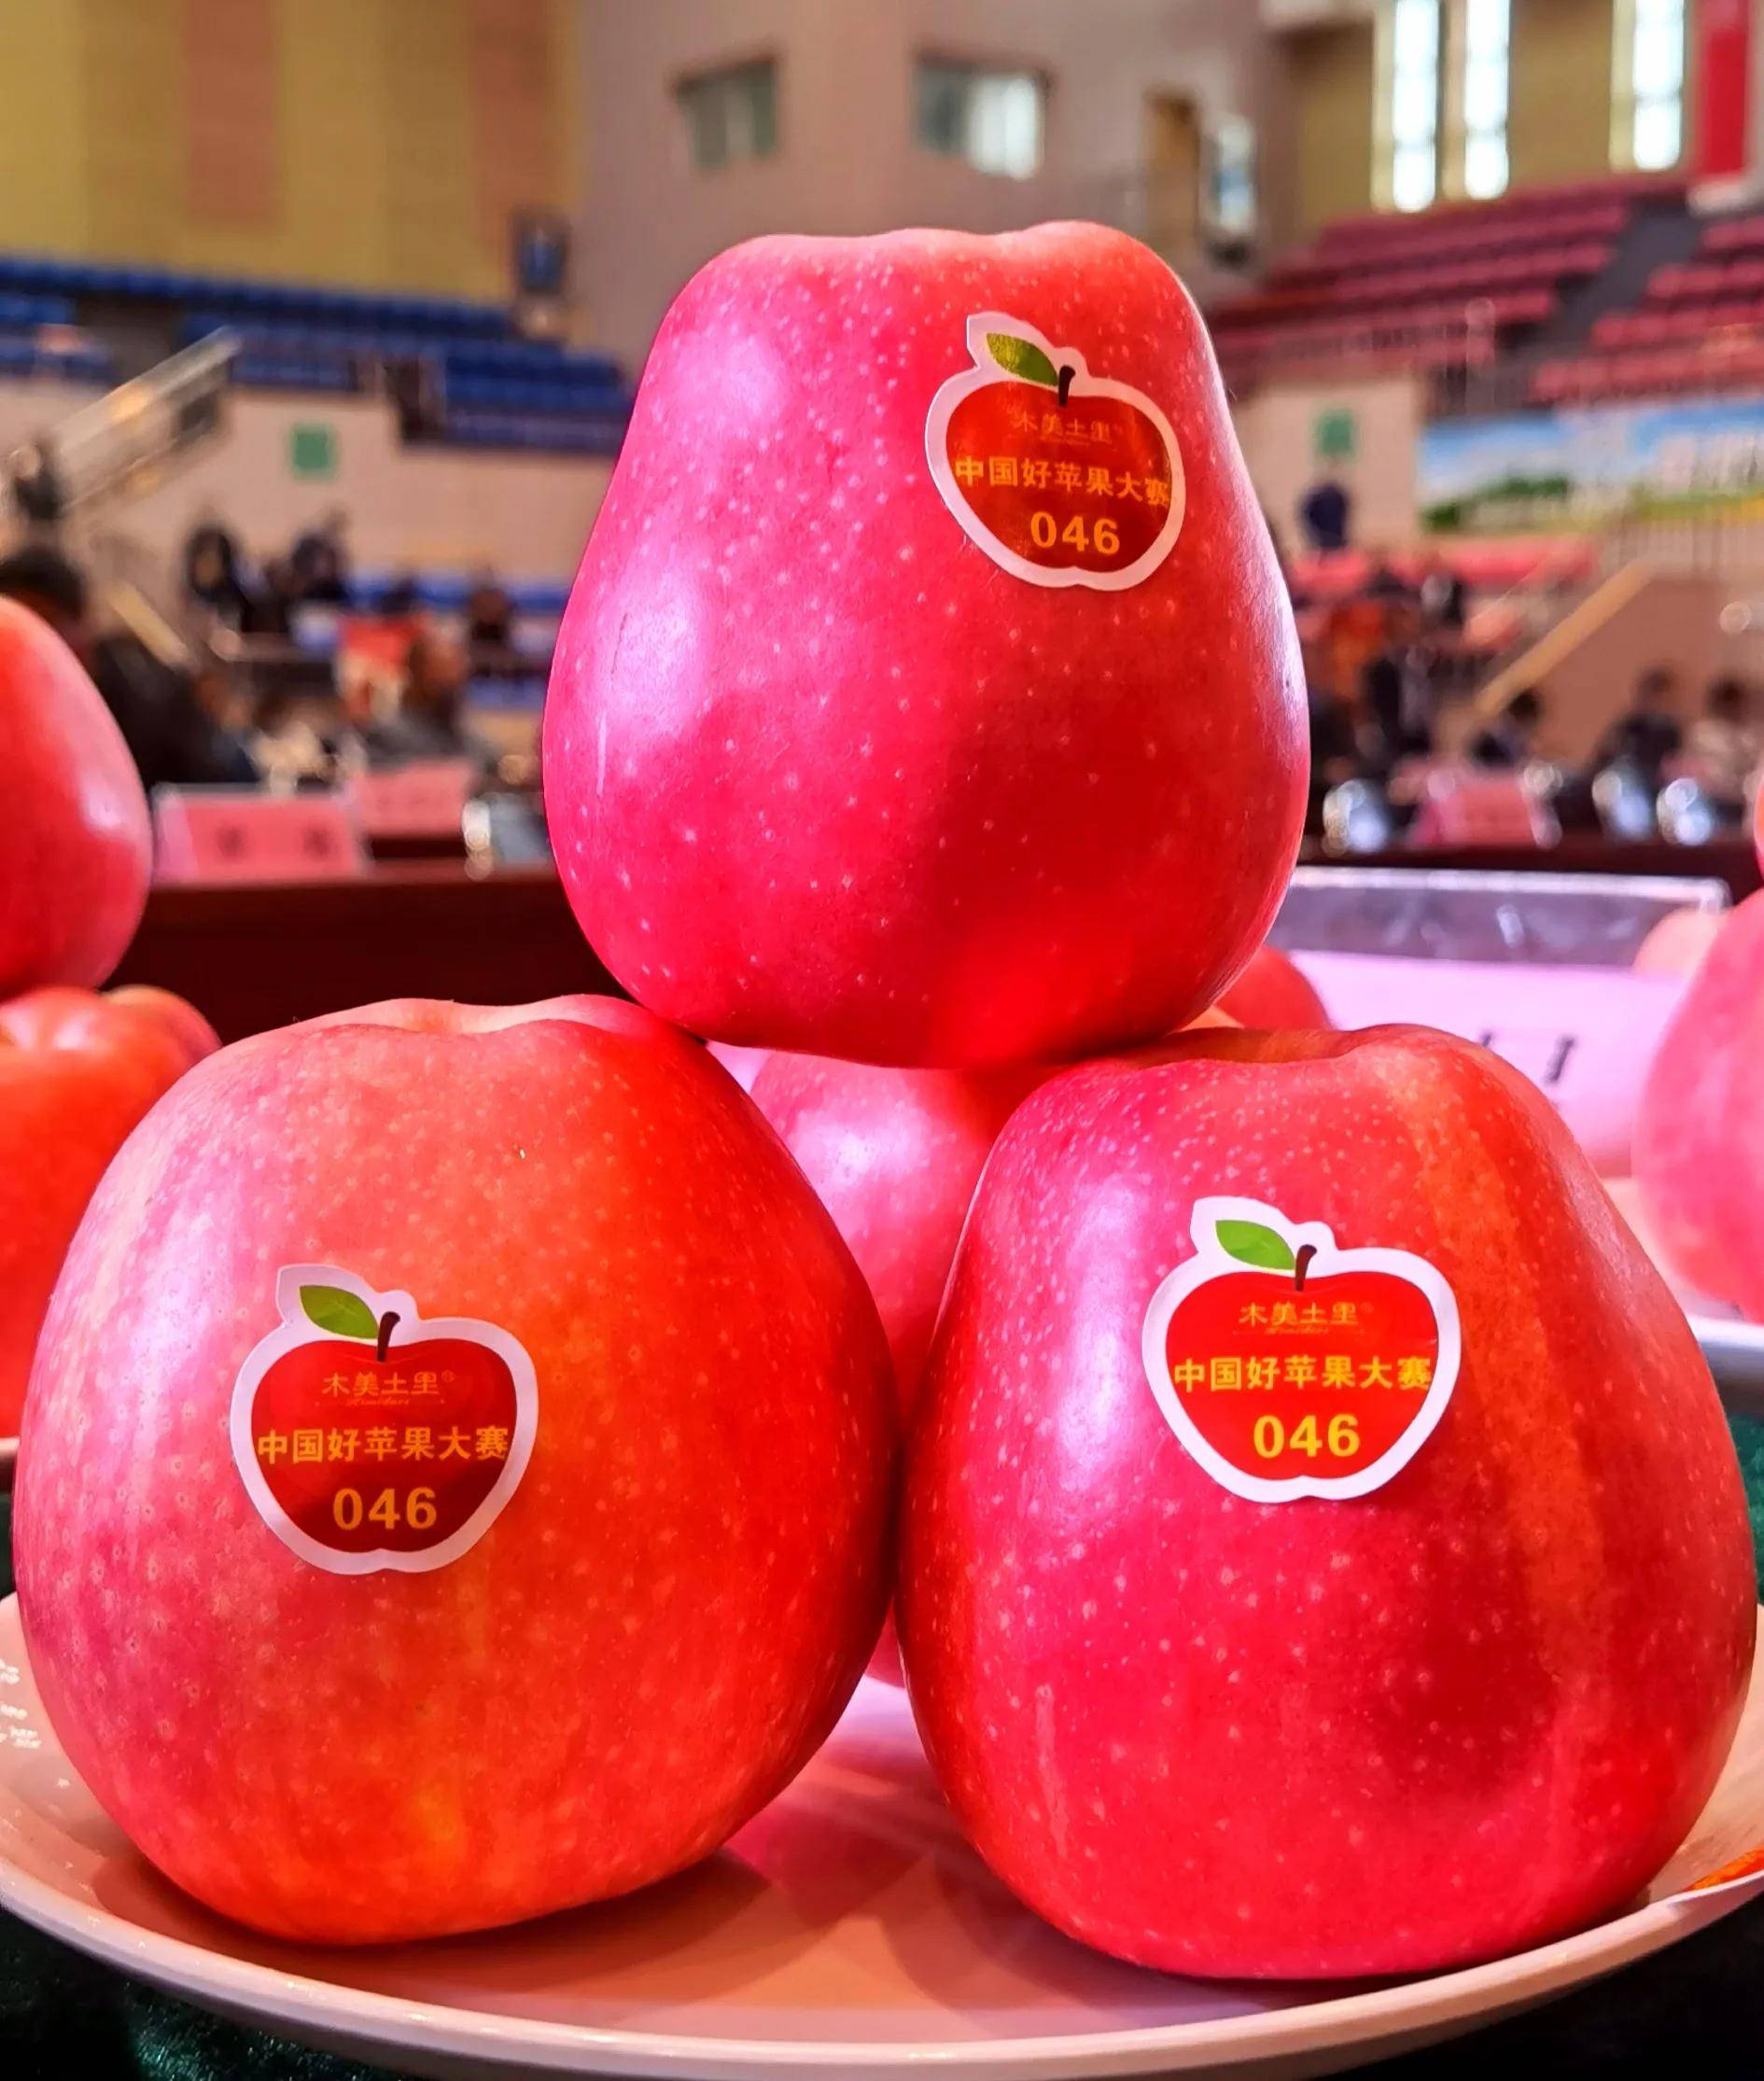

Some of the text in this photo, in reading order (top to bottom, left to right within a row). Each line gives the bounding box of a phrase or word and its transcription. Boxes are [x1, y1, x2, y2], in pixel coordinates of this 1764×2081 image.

[954, 456, 1169, 508] 中国好苹果大赛
[1030, 511, 1120, 554] 046
[1174, 1354, 1431, 1393] 中国好苹果大赛
[258, 1424, 509, 1464] 中国好苹果大赛
[1253, 1414, 1361, 1458] 046
[333, 1487, 438, 1530] 046
